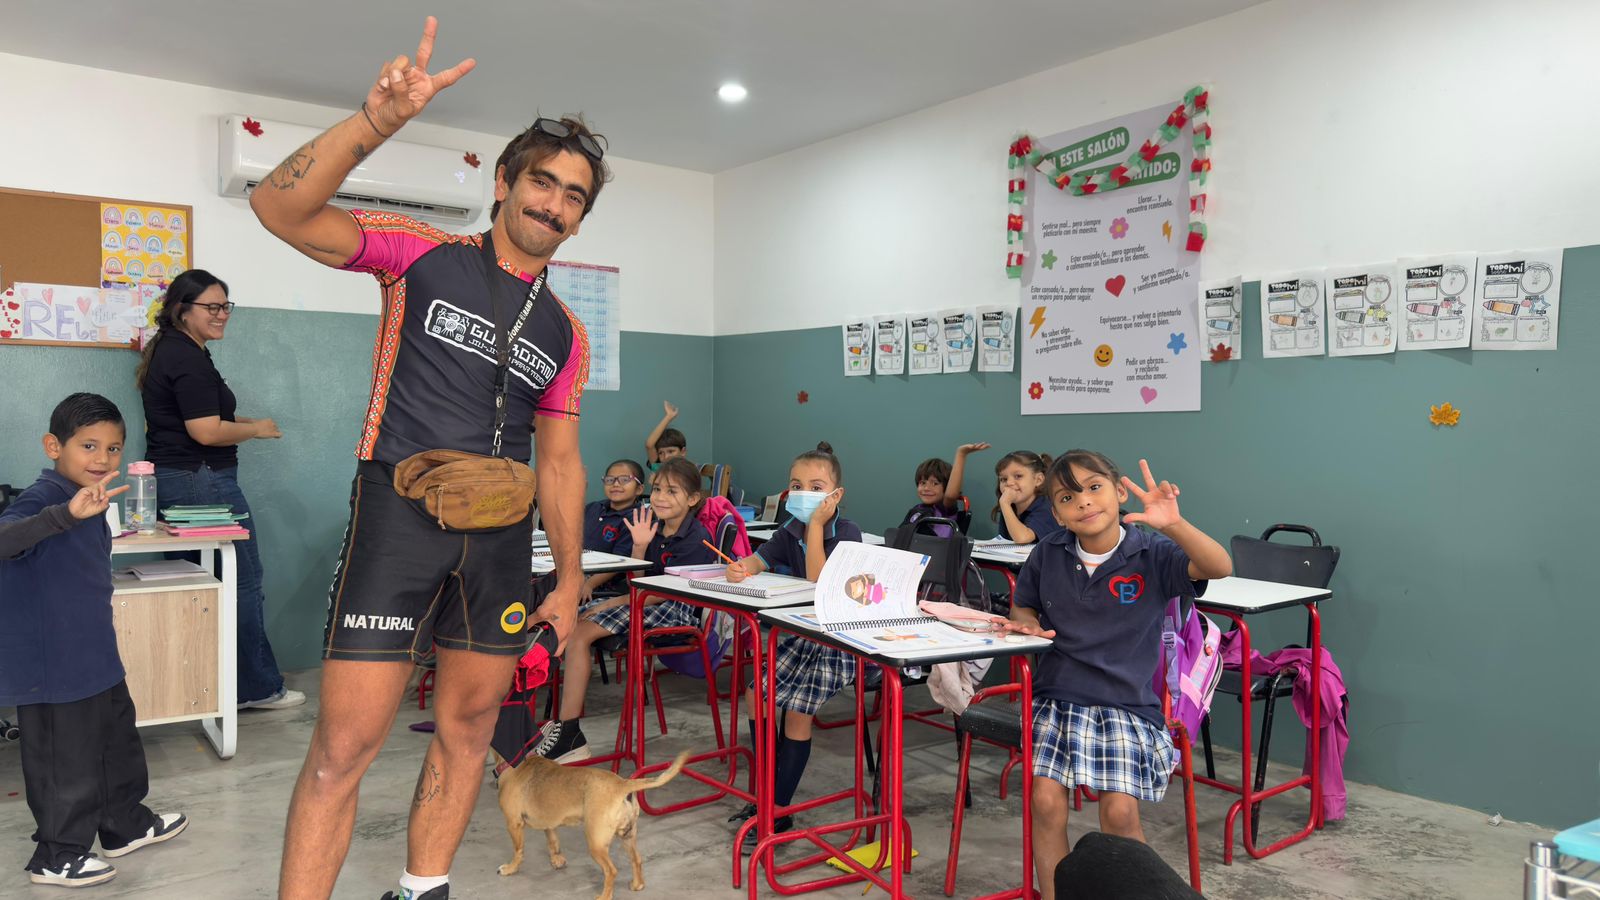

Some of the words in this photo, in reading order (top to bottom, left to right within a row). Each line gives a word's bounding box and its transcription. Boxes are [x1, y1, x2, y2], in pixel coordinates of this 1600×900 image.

[1060, 145, 1084, 167] ESTE
[1087, 132, 1125, 158] SALÓN
[1042, 222, 1058, 230] Sentirse
[1124, 244, 1145, 255] aprender
[1070, 262, 1092, 270] calmarme
[1100, 257, 1119, 265] lastimar
[1151, 273, 1156, 281] yo
[1080, 285, 1094, 293] darme
[1137, 281, 1158, 291] sentirme
[1064, 293, 1076, 302] poder
[1077, 294, 1092, 302] seguir.
[1157, 308, 1181, 317] intentarlo
[1110, 320, 1122, 329] hasta
[1144, 319, 1156, 328] salga
[1050, 335, 1071, 344] atreverme
[470, 324, 553, 379] GURDIAN
[1040, 345, 1059, 354] preguntar
[1126, 358, 1138, 366] Pedir
[1050, 383, 1065, 392] alguien
[1120, 584, 1137, 605] B
[344, 614, 414, 631] NATURAL
